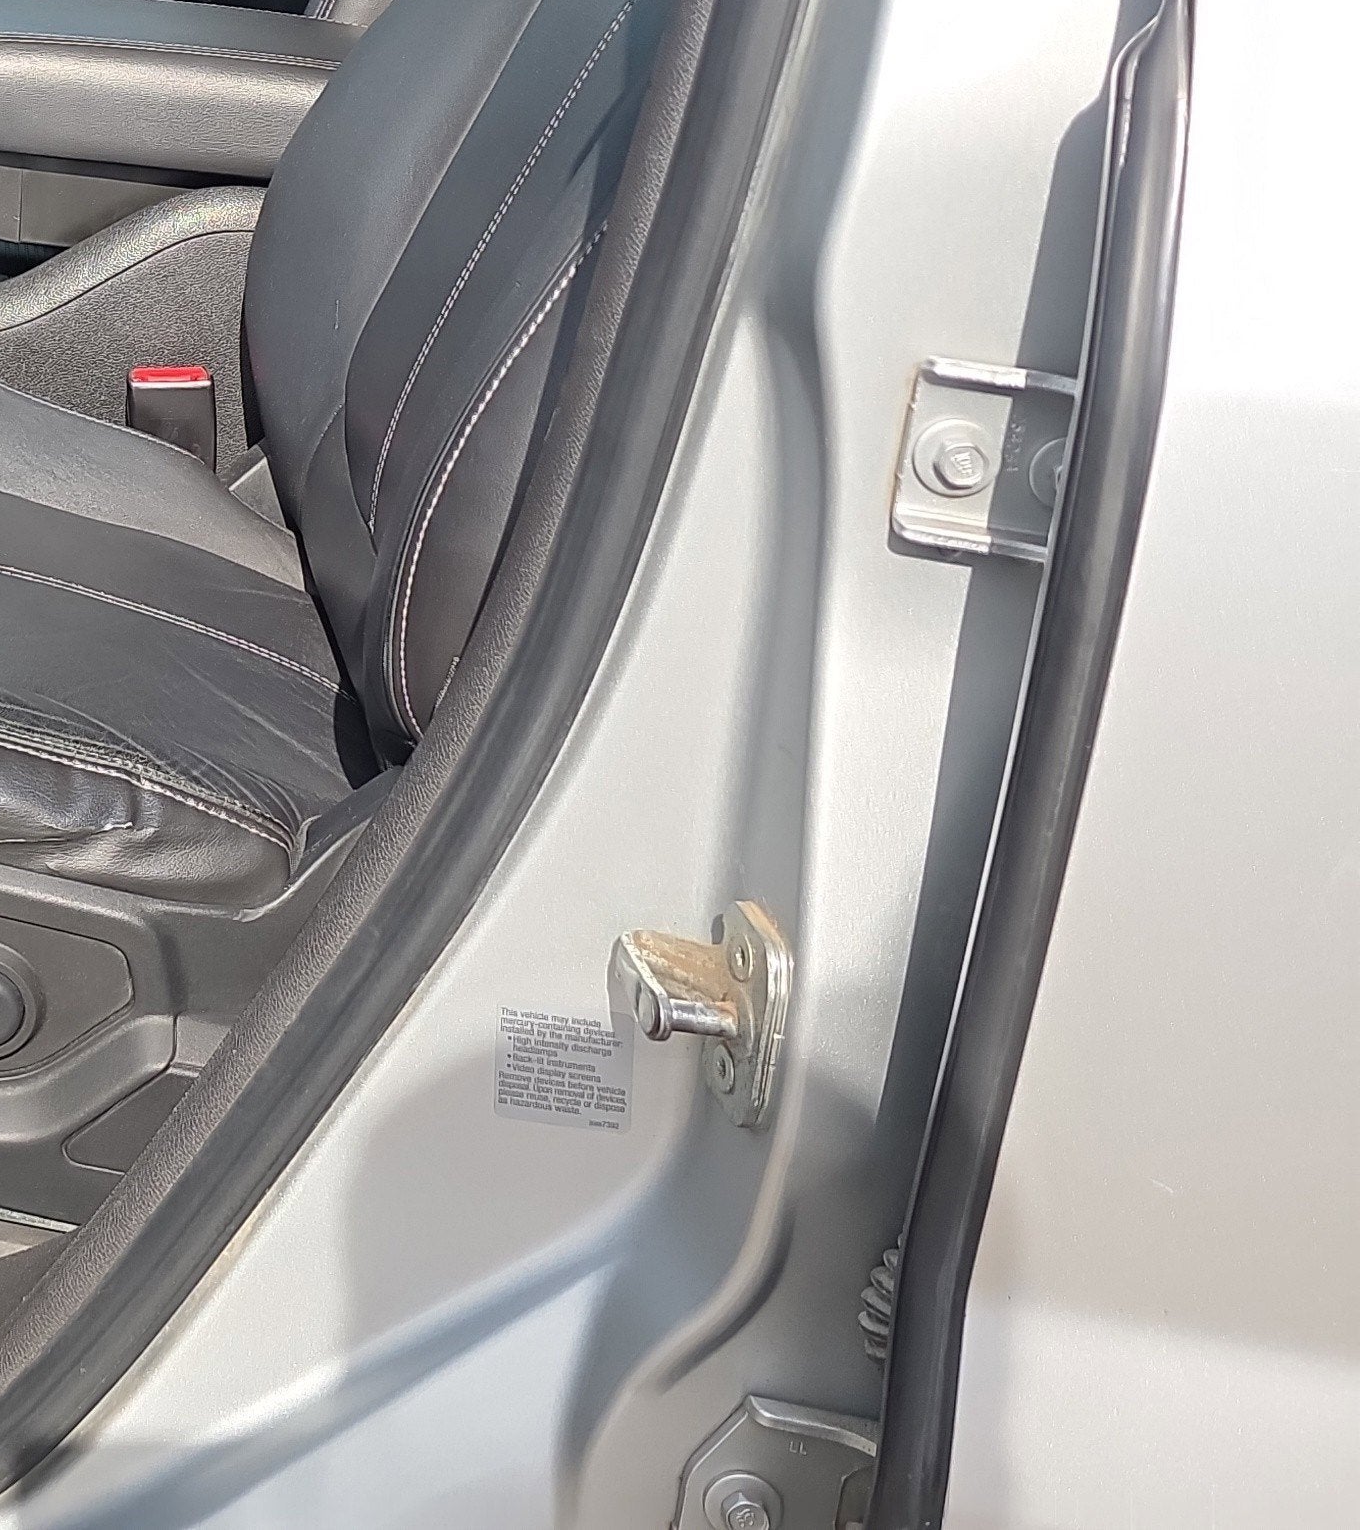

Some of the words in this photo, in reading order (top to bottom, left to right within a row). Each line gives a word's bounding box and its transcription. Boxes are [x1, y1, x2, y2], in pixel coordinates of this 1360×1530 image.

[502, 1008, 518, 1016] This
[520, 1010, 548, 1020] vehicle
[572, 1017, 601, 1028] include
[501, 1016, 580, 1036] mercury-containing
[584, 1027, 615, 1038] devices
[513, 1035, 532, 1044] High
[534, 1038, 569, 1051] intensity
[571, 1044, 612, 1057] discharge
[513, 1043, 557, 1057] headlamps
[547, 1059, 595, 1072] instruments
[537, 1067, 566, 1079] display
[568, 1073, 601, 1082] screens
[499, 1071, 531, 1082] Remove
[534, 1076, 565, 1087] devices
[568, 1081, 594, 1091] before
[597, 1085, 626, 1096] vehicle
[555, 1088, 585, 1098] removal
[510, 1098, 552, 1110] hazardous
[555, 1106, 581, 1115] waste.
[553, 1097, 581, 1108] recycle
[594, 1102, 625, 1114] dispose
